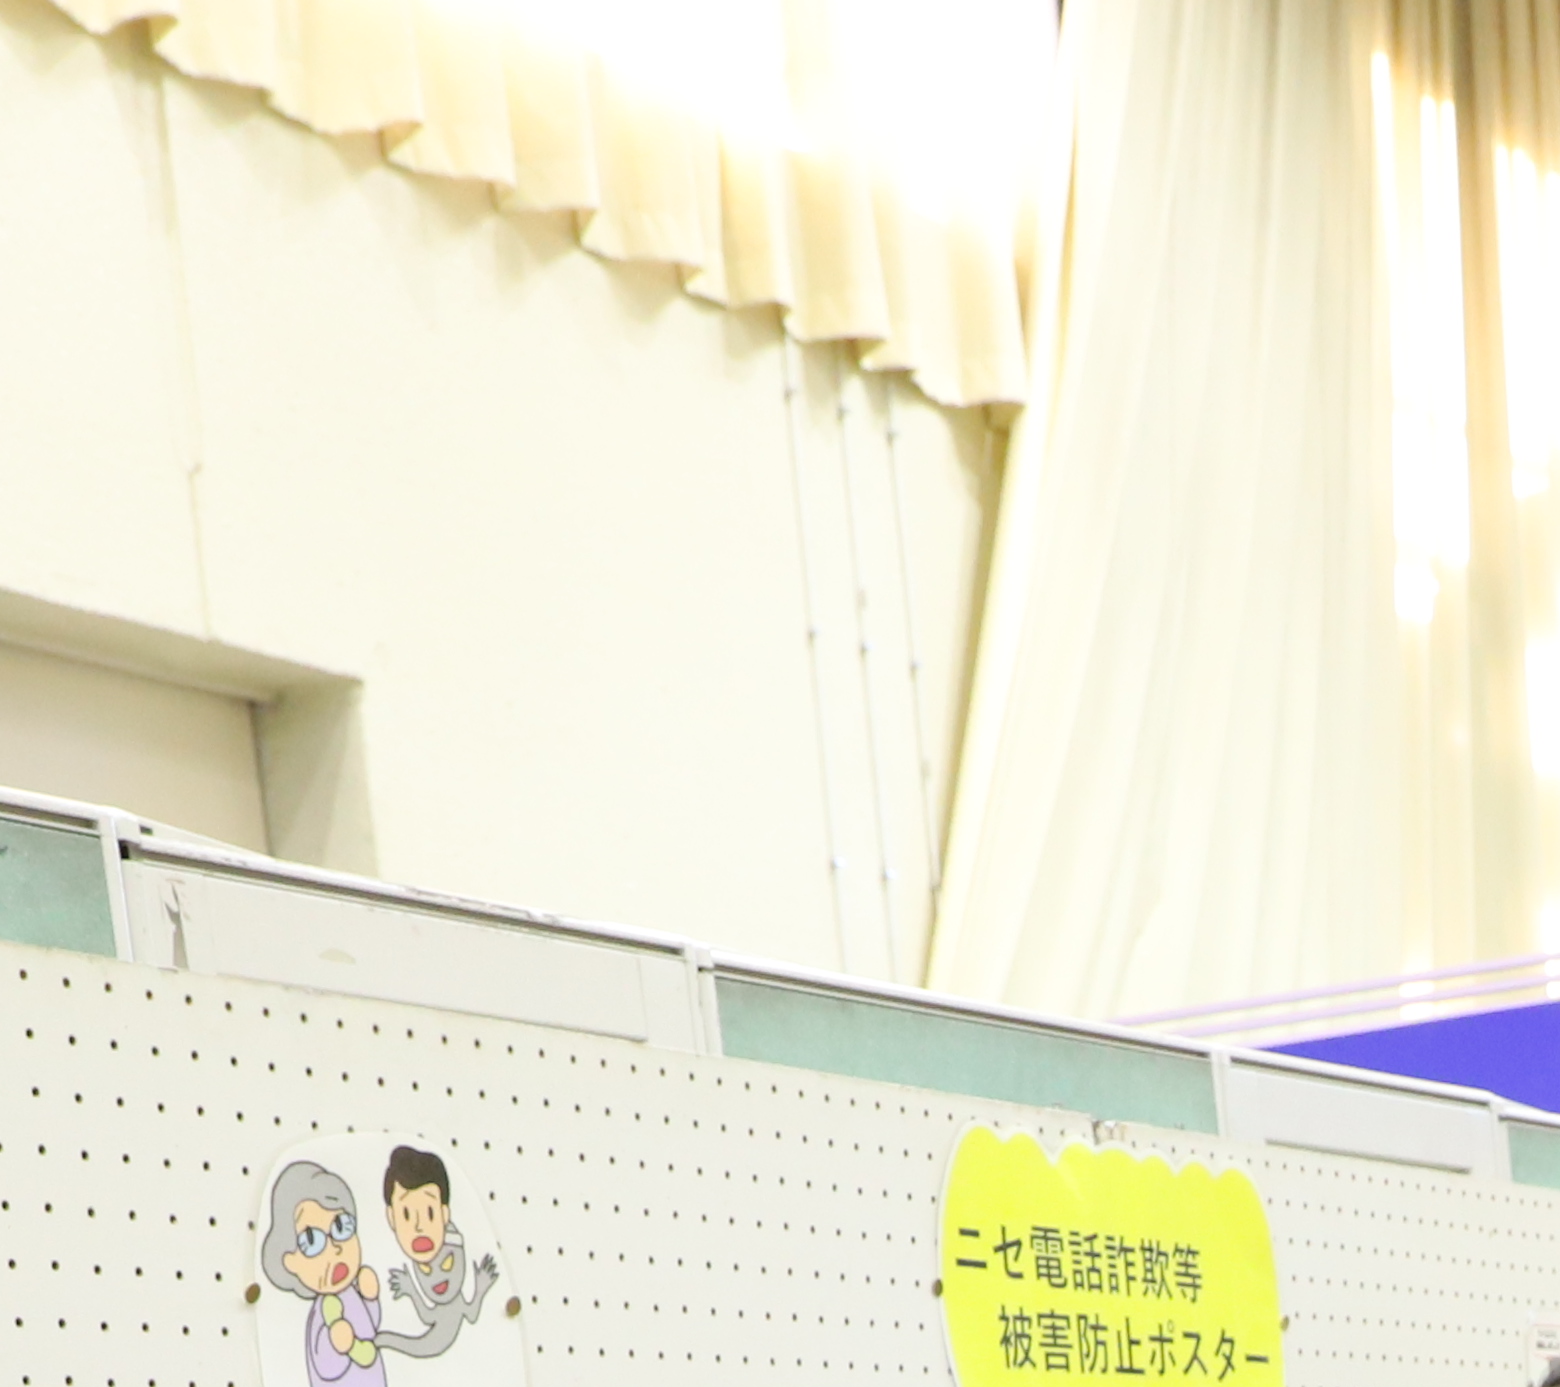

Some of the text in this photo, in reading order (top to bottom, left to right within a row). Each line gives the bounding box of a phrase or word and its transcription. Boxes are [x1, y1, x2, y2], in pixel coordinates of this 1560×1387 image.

[955, 1225, 1203, 1304] ニセ電話詐欺等
[998, 1304, 1270, 1382] 被害防止ポスター
